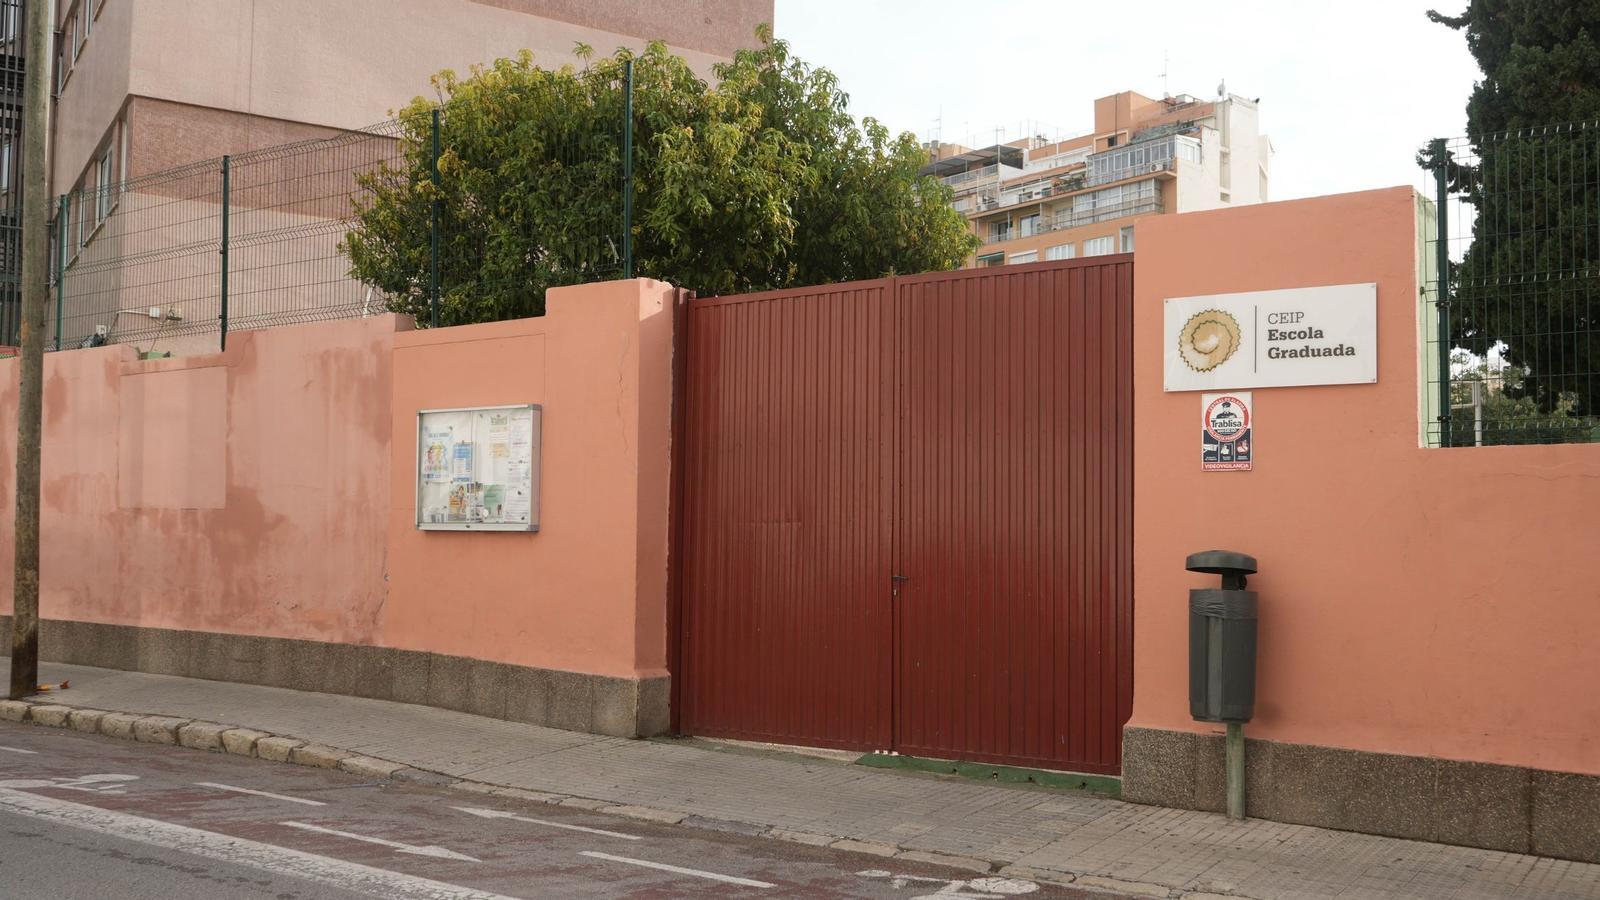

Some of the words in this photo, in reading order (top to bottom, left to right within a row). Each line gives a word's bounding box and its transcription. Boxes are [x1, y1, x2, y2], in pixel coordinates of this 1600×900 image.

[1267, 312, 1305, 325] CEIP
[1267, 327, 1324, 341] Escola
[1267, 344, 1356, 359] Graduada
[1211, 419, 1242, 428] Trablisa
